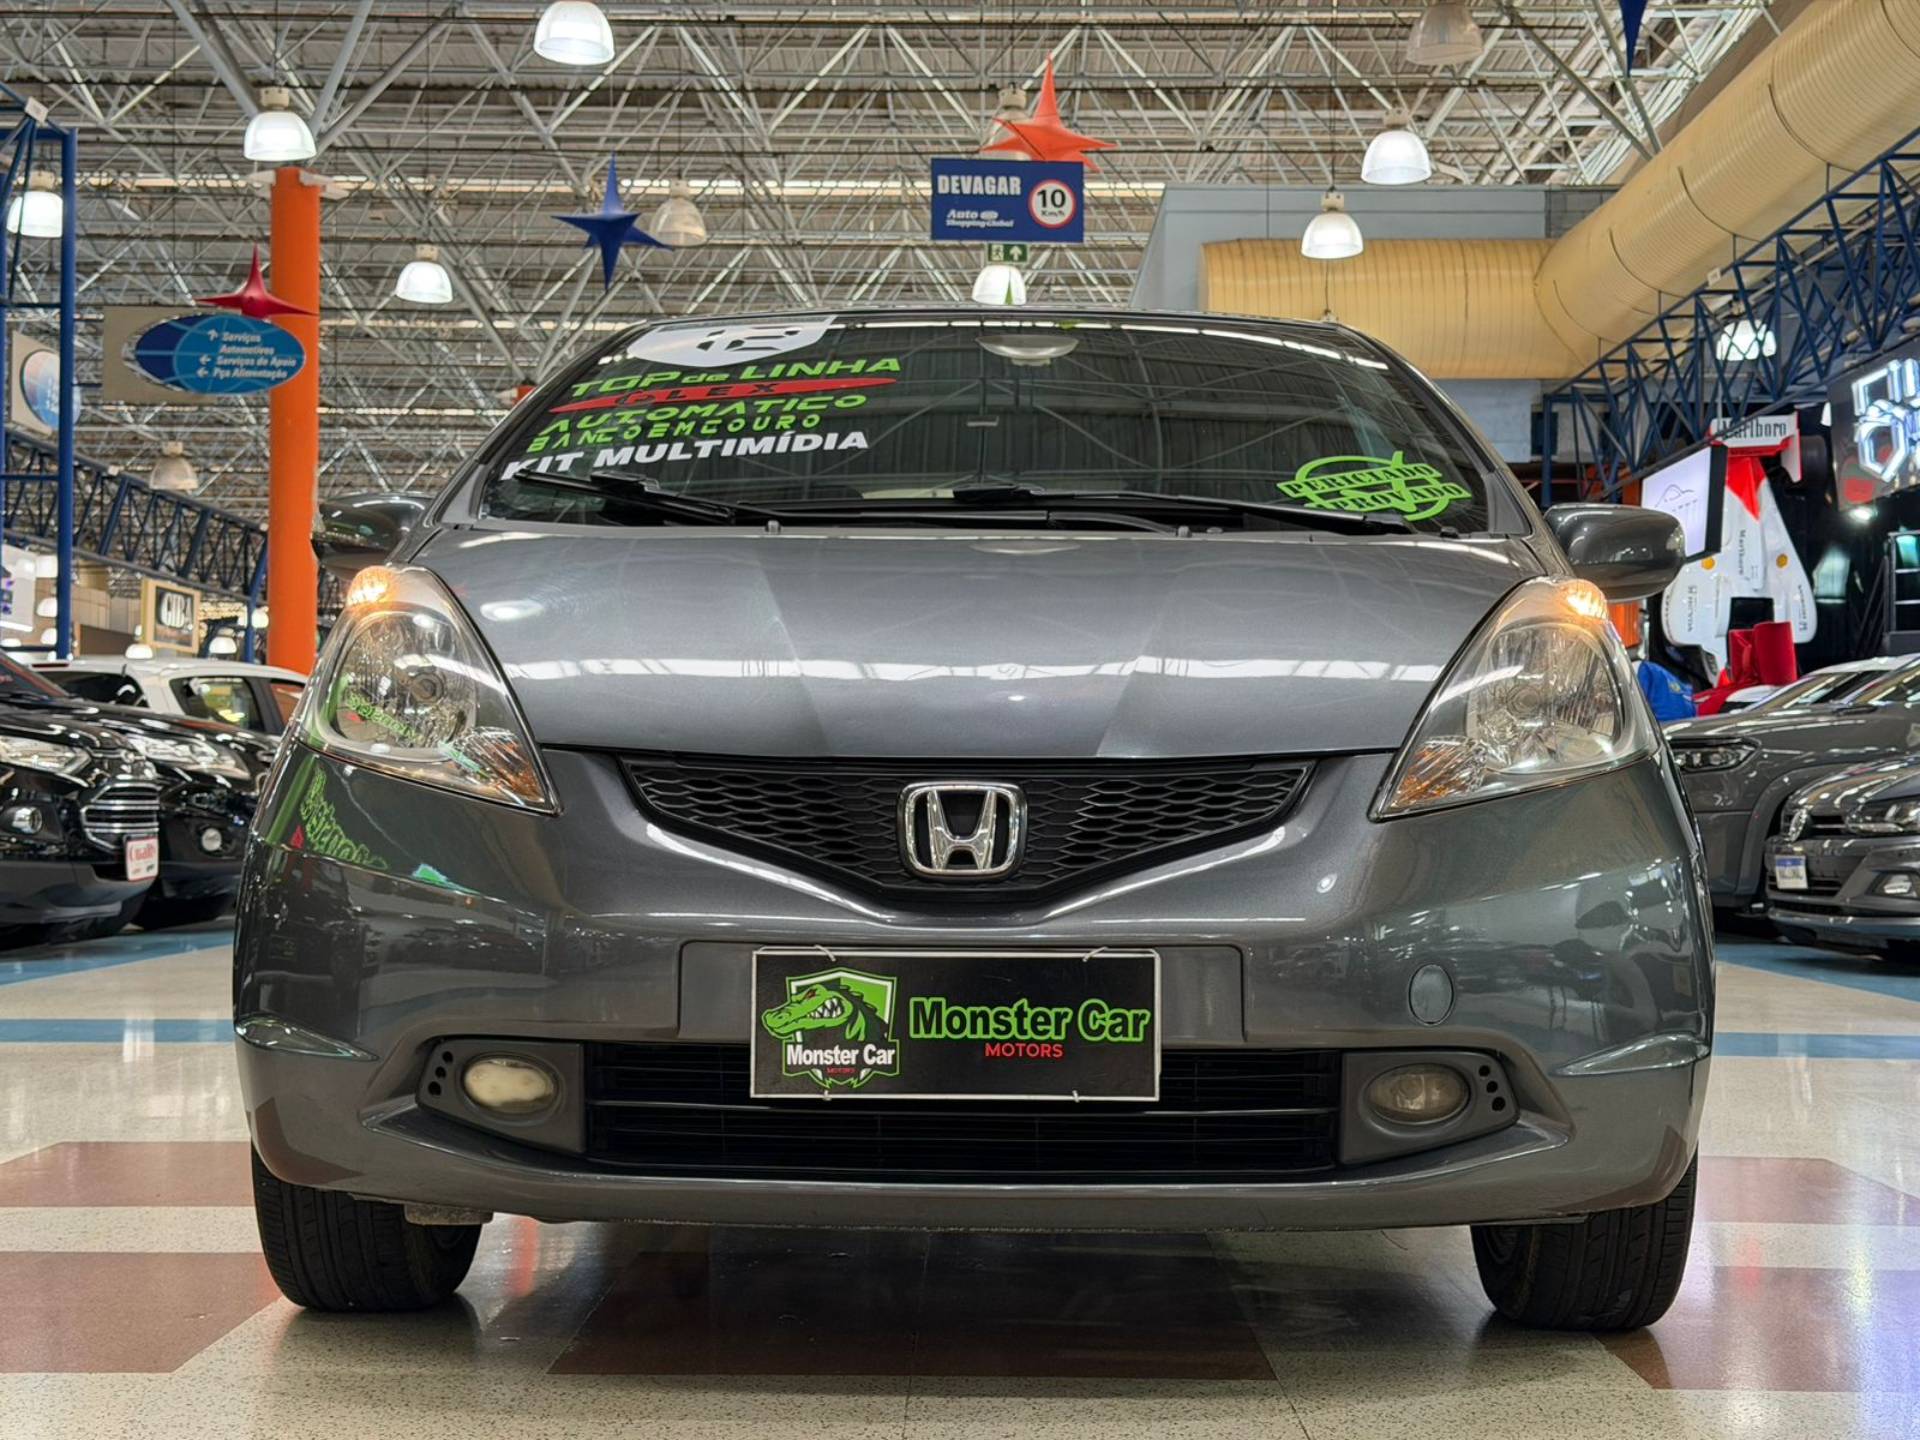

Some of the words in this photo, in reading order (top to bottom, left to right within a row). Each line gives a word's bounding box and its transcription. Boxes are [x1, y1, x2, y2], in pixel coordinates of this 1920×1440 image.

[937, 175, 1021, 195] DEVAGAR
[1037, 189, 1066, 208] 10
[946, 209, 979, 220] Auto
[222, 332, 261, 344] Serviços
[219, 345, 275, 355] Automotivos
[216, 356, 255, 367] Serviços
[232, 369, 288, 380] Alimentação
[571, 371, 681, 397] TOP
[681, 373, 730, 384] de
[740, 358, 901, 380] LINHA
[500, 451, 585, 481] KIT
[592, 430, 869, 469] MULTIMÍDIA
[1281, 464, 1435, 496] PERICIADO
[910, 997, 1073, 1040] Monster
[1078, 998, 1151, 1042] Car
[786, 1044, 860, 1066] Monster
[863, 1043, 896, 1066] Car
[984, 1042, 1063, 1058] MOTORS
